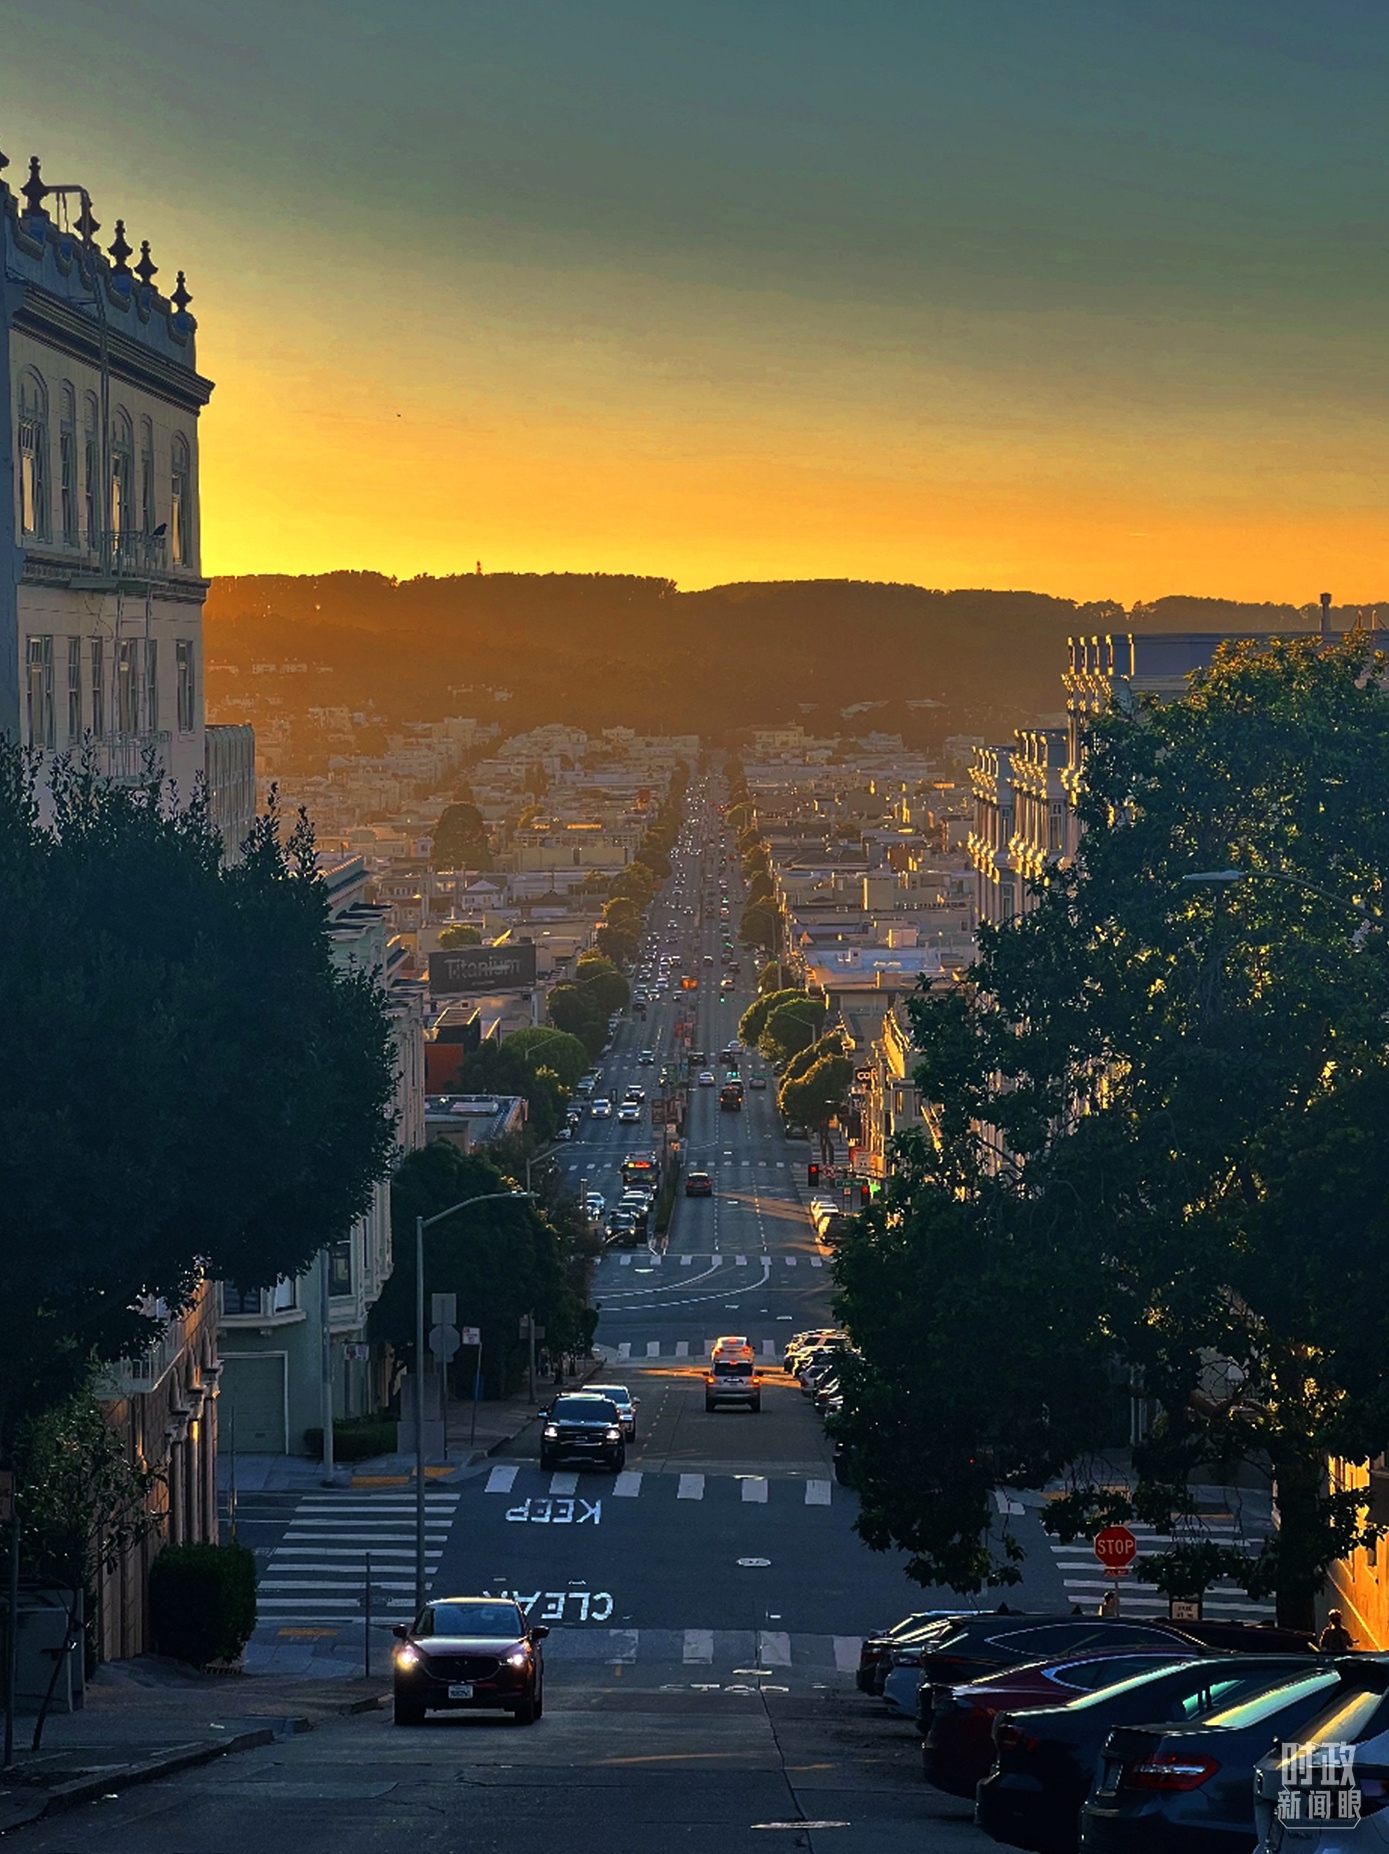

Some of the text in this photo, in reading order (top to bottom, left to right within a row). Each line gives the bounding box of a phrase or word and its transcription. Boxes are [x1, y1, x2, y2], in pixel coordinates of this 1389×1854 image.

[443, 956, 520, 979] Titanium
[505, 1498, 602, 1524] KEEP
[1097, 1540, 1134, 1555] STOP
[483, 1591, 614, 1621] CLEA
